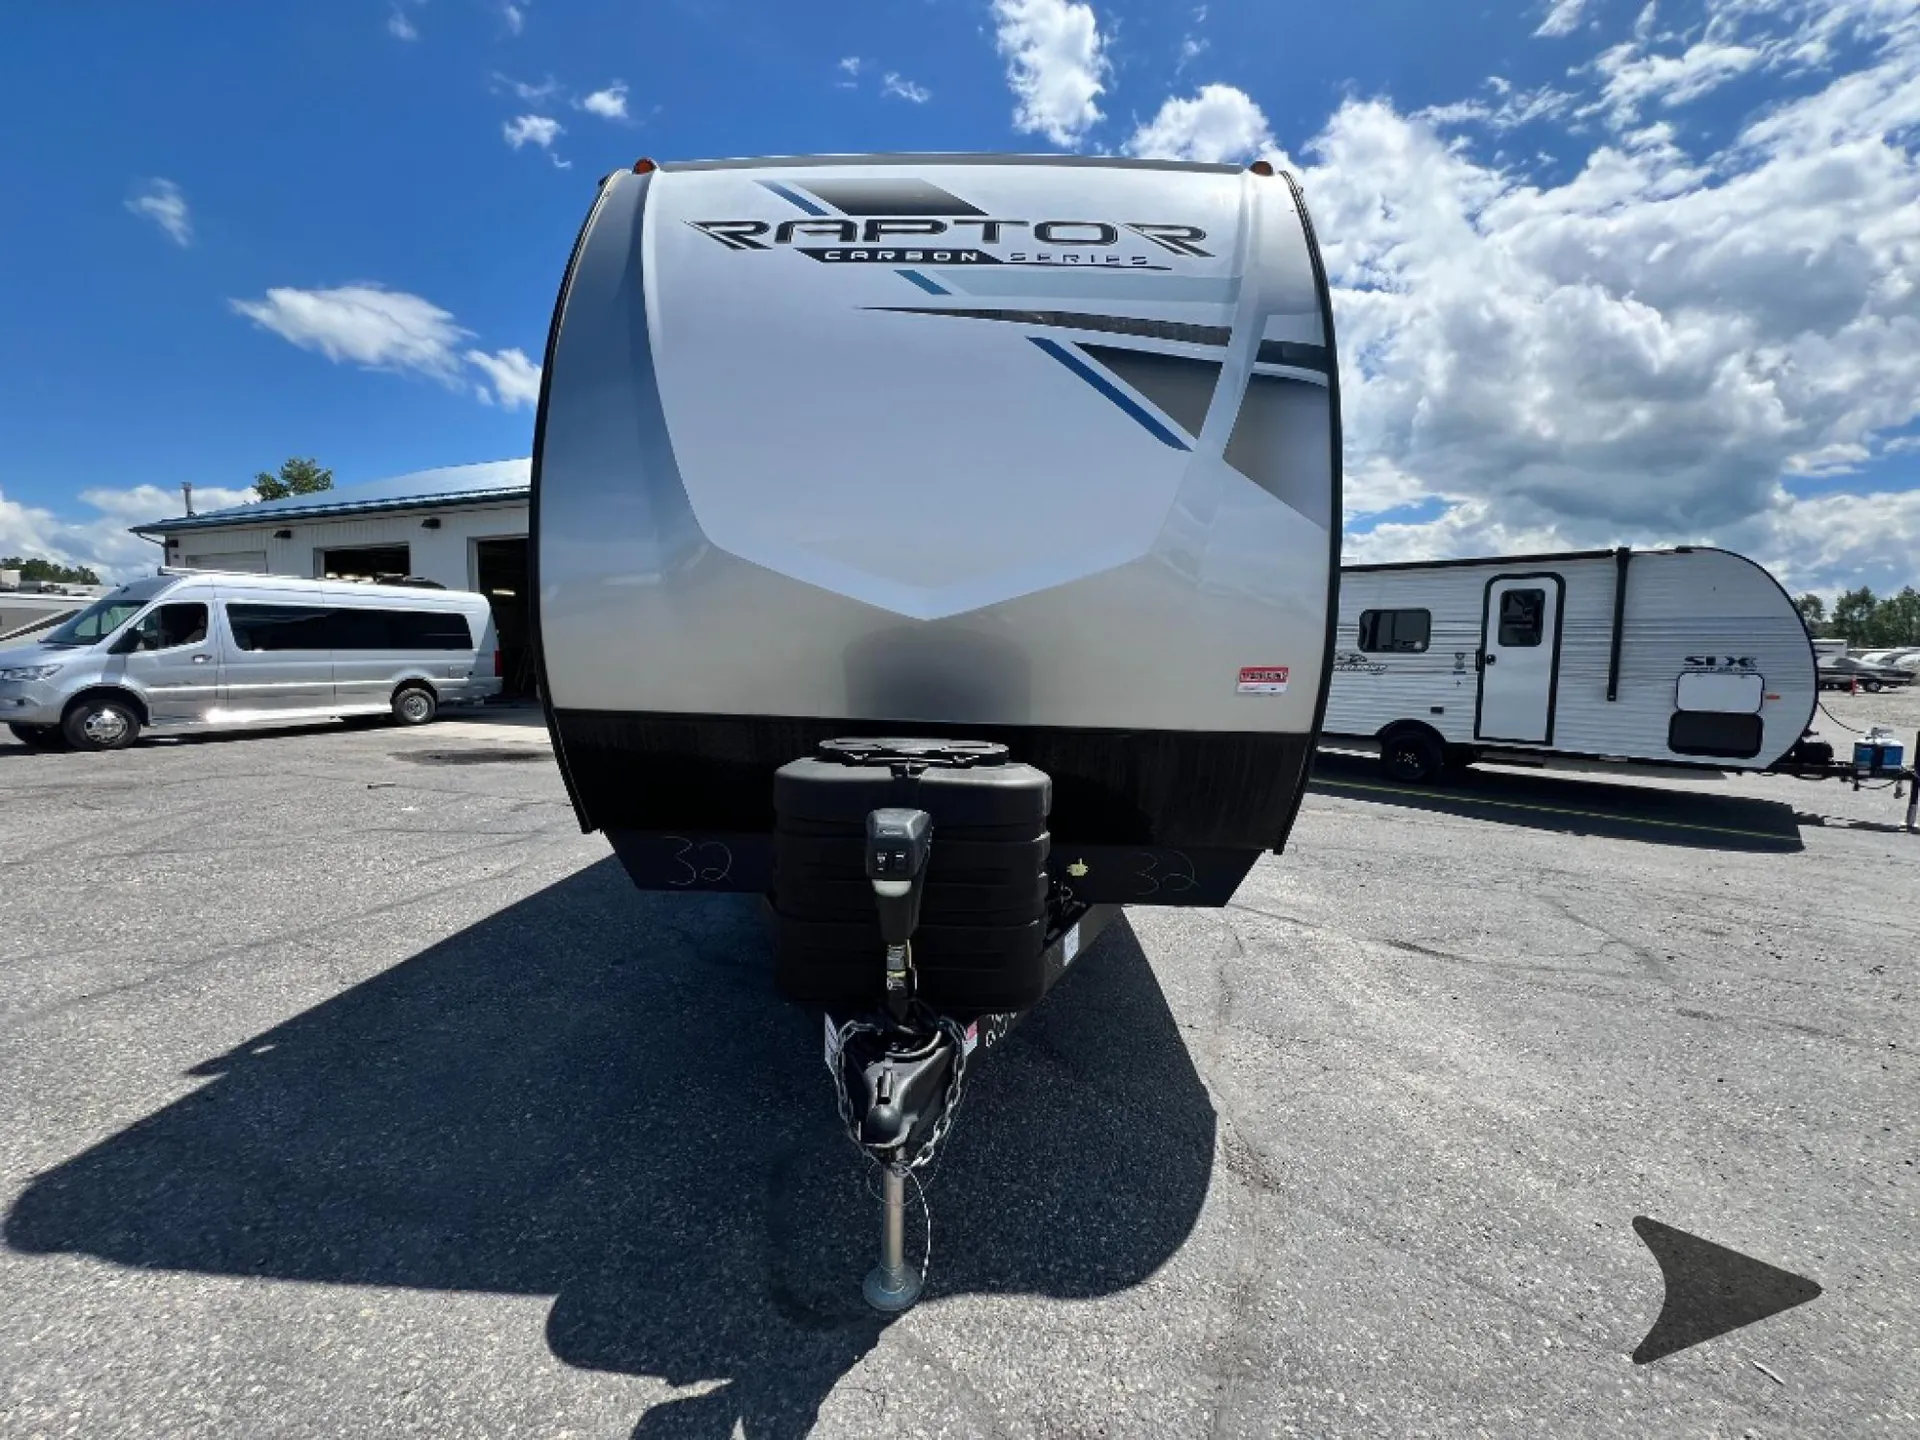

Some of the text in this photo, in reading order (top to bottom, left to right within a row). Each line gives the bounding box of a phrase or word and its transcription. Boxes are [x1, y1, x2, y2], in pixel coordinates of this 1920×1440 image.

[682, 219, 1216, 257] RAPTOR
[824, 250, 1148, 265] CARBON SERIES
[663, 835, 736, 886] 32
[1130, 849, 1200, 896] 32
